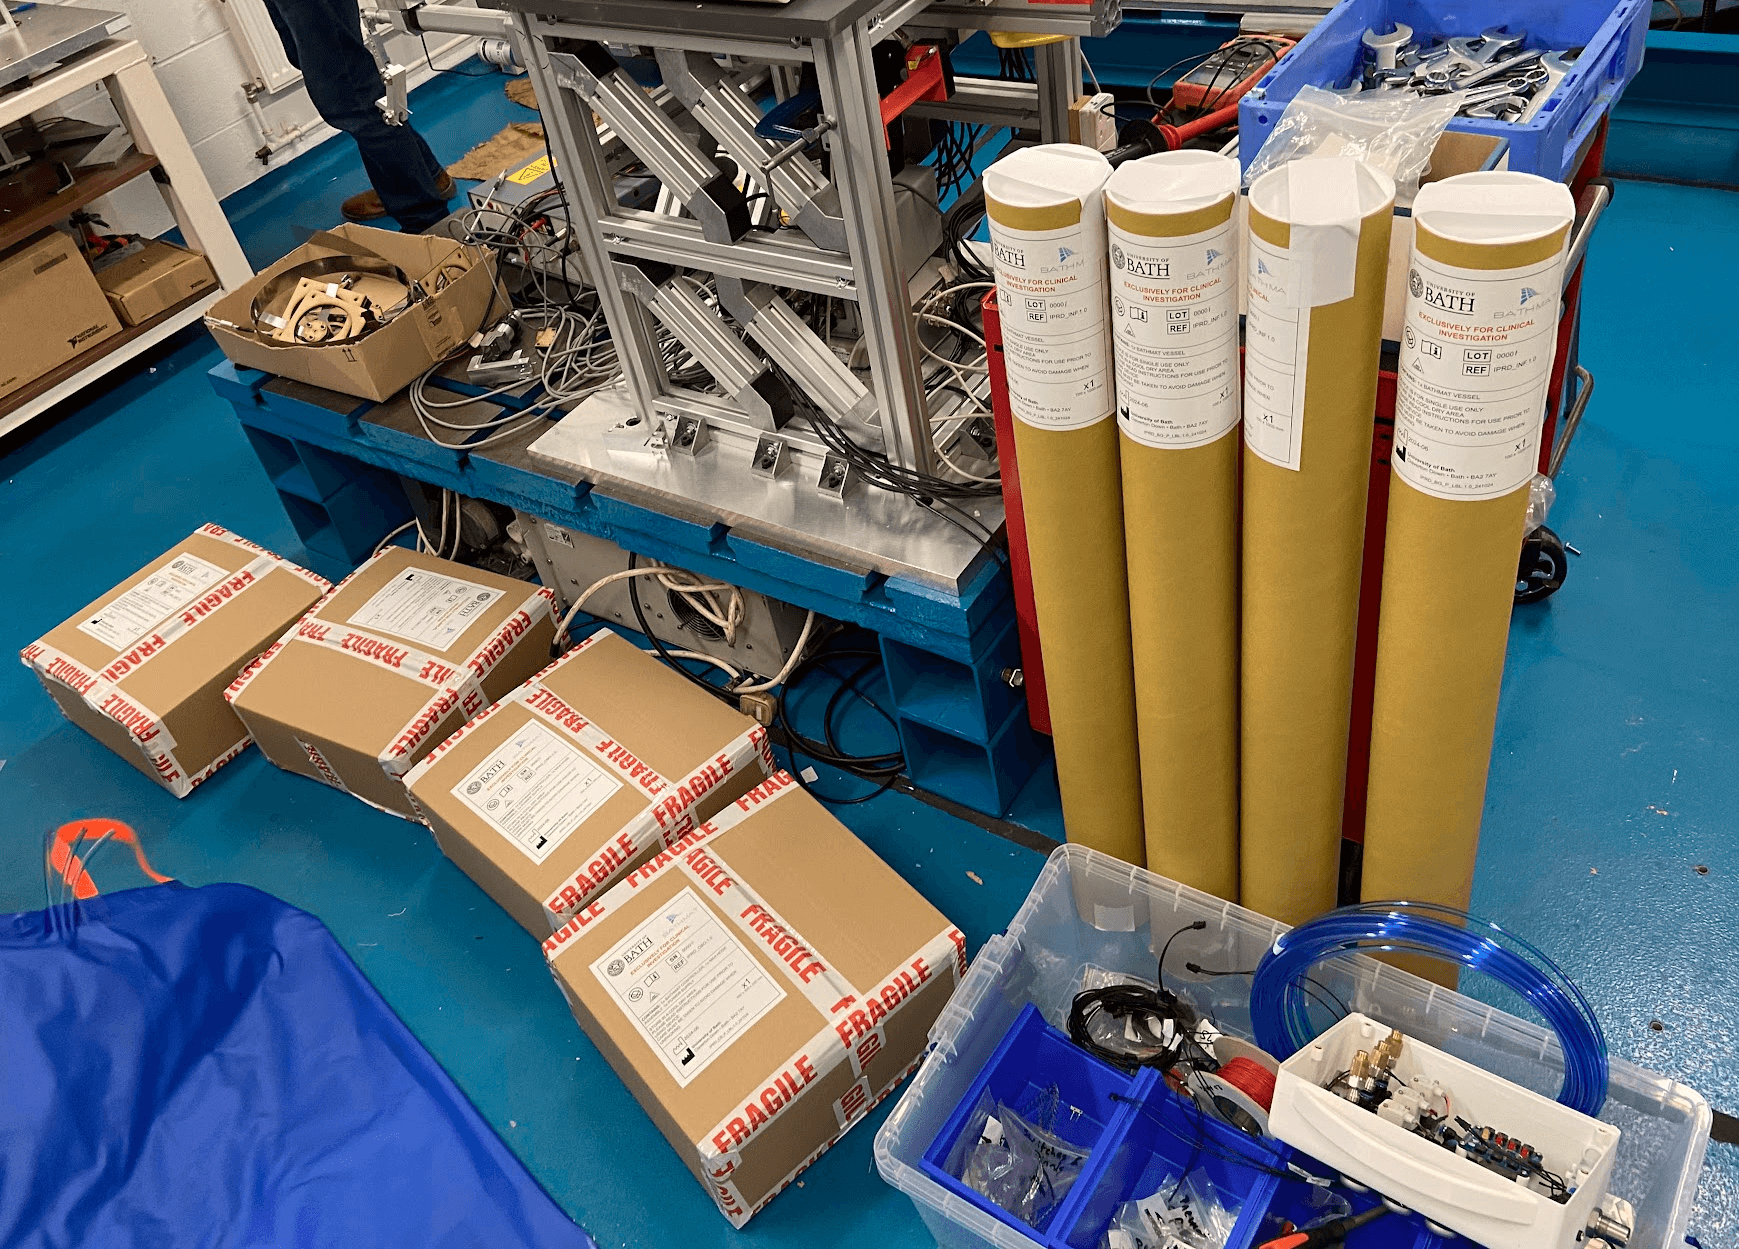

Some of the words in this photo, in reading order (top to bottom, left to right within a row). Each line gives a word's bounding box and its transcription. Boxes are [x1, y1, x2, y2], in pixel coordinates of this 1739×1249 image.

[994, 243, 1025, 267] BATH
[1127, 252, 1160, 262] UNIVERSITY
[1127, 258, 1170, 276] BATH
[1006, 280, 1056, 292] INVESTIGATION
[1044, 275, 1078, 285] CLINICAL
[1124, 281, 1170, 295] EXCLUSIVELY
[1190, 278, 1221, 291] CLINICAL
[1426, 281, 1464, 296] UNIVERSITY
[1142, 292, 1200, 302] INVESTIGATION
[1425, 286, 1475, 312] BATH
[1169, 312, 1187, 320] LOT
[1418, 311, 1471, 332] EXCLUSIVELY
[1496, 320, 1534, 332] CLINICAL
[77, 324, 98, 338] NATIONAL
[1439, 329, 1508, 341] INVESTIGATION
[1467, 352, 1489, 360] LOT
[1466, 366, 1487, 374] REF
[1187, 378, 1210, 389] DAMAGE
[1423, 383, 1452, 397] BATHMAT
[1425, 397, 1448, 409] SINGLE
[1264, 414, 1273, 423] x1
[1422, 409, 1470, 425] INSTRUCTIONS
[1423, 422, 1443, 433] TAKEN
[1477, 428, 1507, 437] DAMAGE
[1514, 438, 1526, 452] x1
[1407, 452, 1431, 469] University
[180, 570, 255, 626] FRAGILE
[341, 632, 409, 668] FRAGILE
[467, 610, 532, 678] FRAGILE
[45, 657, 98, 697] FRAGILE
[100, 693, 160, 743] FRAGILE
[525, 688, 589, 734] FRAGILE
[389, 688, 459, 756] FRAGILE
[479, 760, 505, 783] BATH
[595, 739, 667, 796] FRAGILE
[650, 753, 735, 829] FRAGILE
[548, 832, 638, 916] FRAGILE
[622, 936, 653, 963] BATH
[629, 948, 660, 976] EXCLUSIVELY
[658, 940, 670, 950] FOR
[668, 923, 690, 942] CLINICAL
[740, 904, 827, 984] FRAGILE
[646, 938, 680, 968] INVESTIGATION
[668, 953, 678, 963] SN
[672, 958, 686, 970] REF
[739, 977, 751, 989] x1
[834, 957, 932, 1050] FRAGILE
[712, 1055, 819, 1154] FRAGILE
